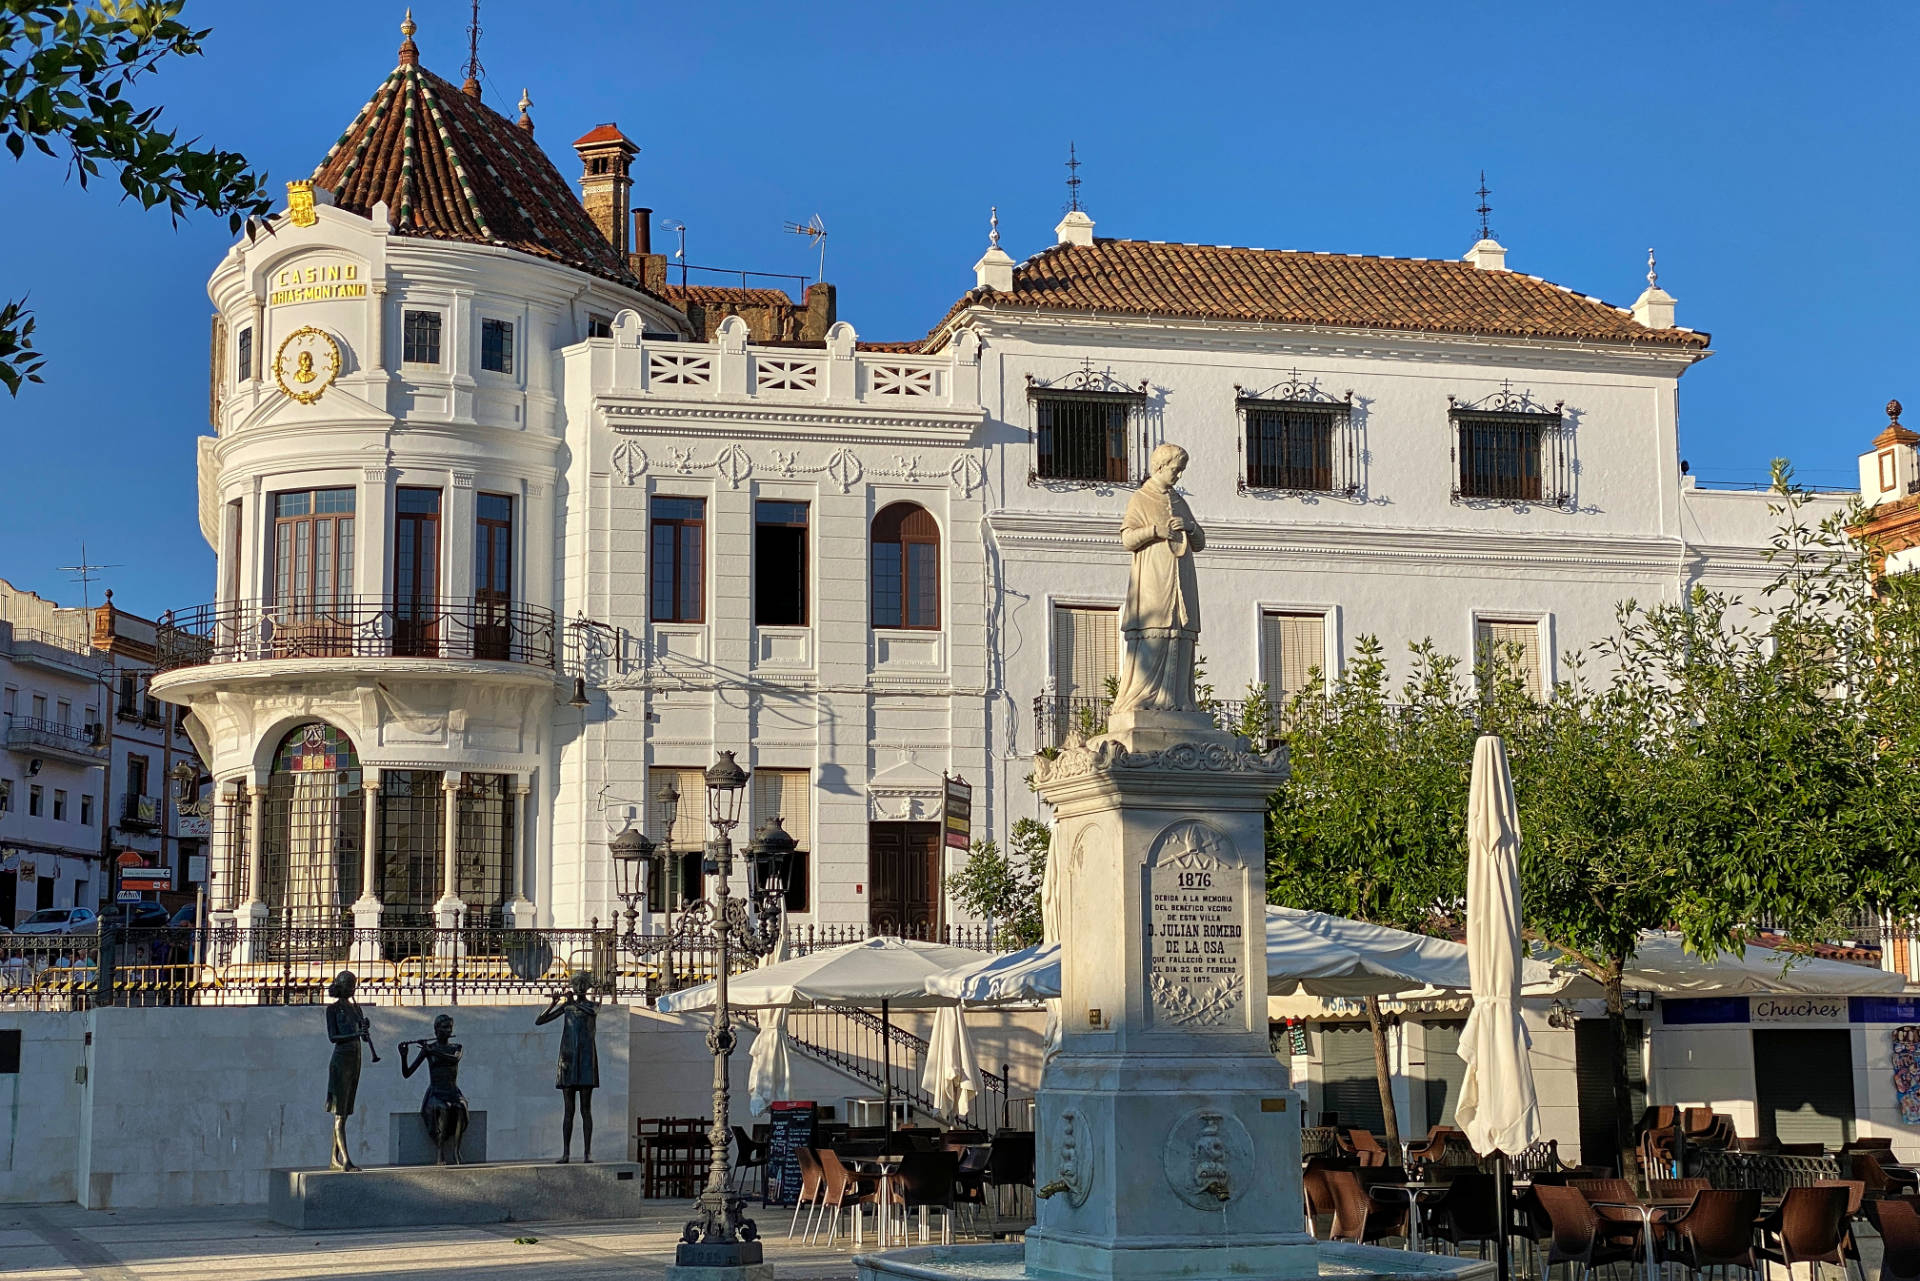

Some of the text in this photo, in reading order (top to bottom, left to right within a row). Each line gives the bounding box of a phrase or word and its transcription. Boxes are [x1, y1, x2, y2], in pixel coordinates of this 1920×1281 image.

[280, 265, 357, 286] CASINO
[1203, 895, 1233, 903] MEMORIA
[1160, 924, 1199, 937] JULIAN
[1203, 925, 1241, 938] ROMERO
[1166, 941, 1225, 954] DE LA OSA
[1757, 1000, 1841, 1017] Chuches
